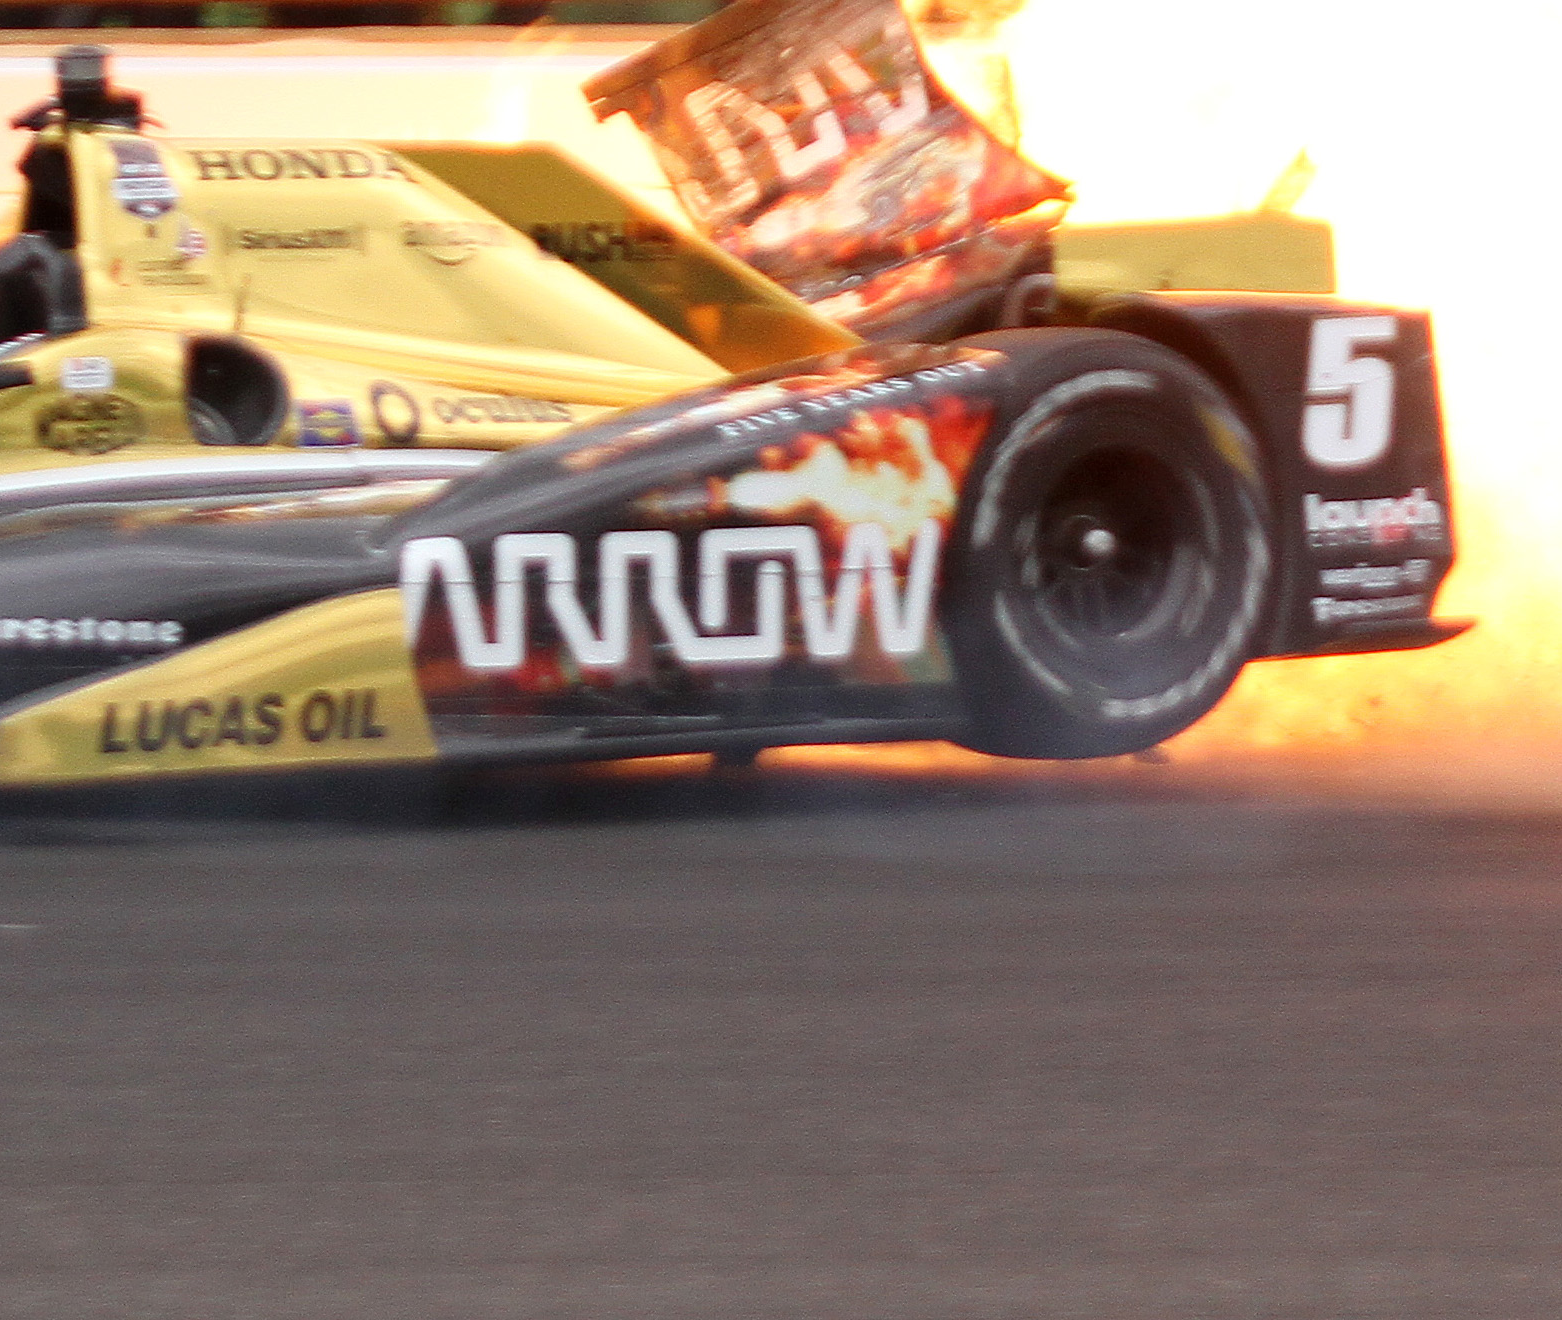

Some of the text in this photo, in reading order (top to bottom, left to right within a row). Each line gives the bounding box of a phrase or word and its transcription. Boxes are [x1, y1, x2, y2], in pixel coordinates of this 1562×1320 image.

[190, 147, 418, 183] HONDA
[1302, 315, 1397, 468] 5
[401, 518, 940, 669] ARROW
[100, 688, 384, 752] LUCAS OIL
